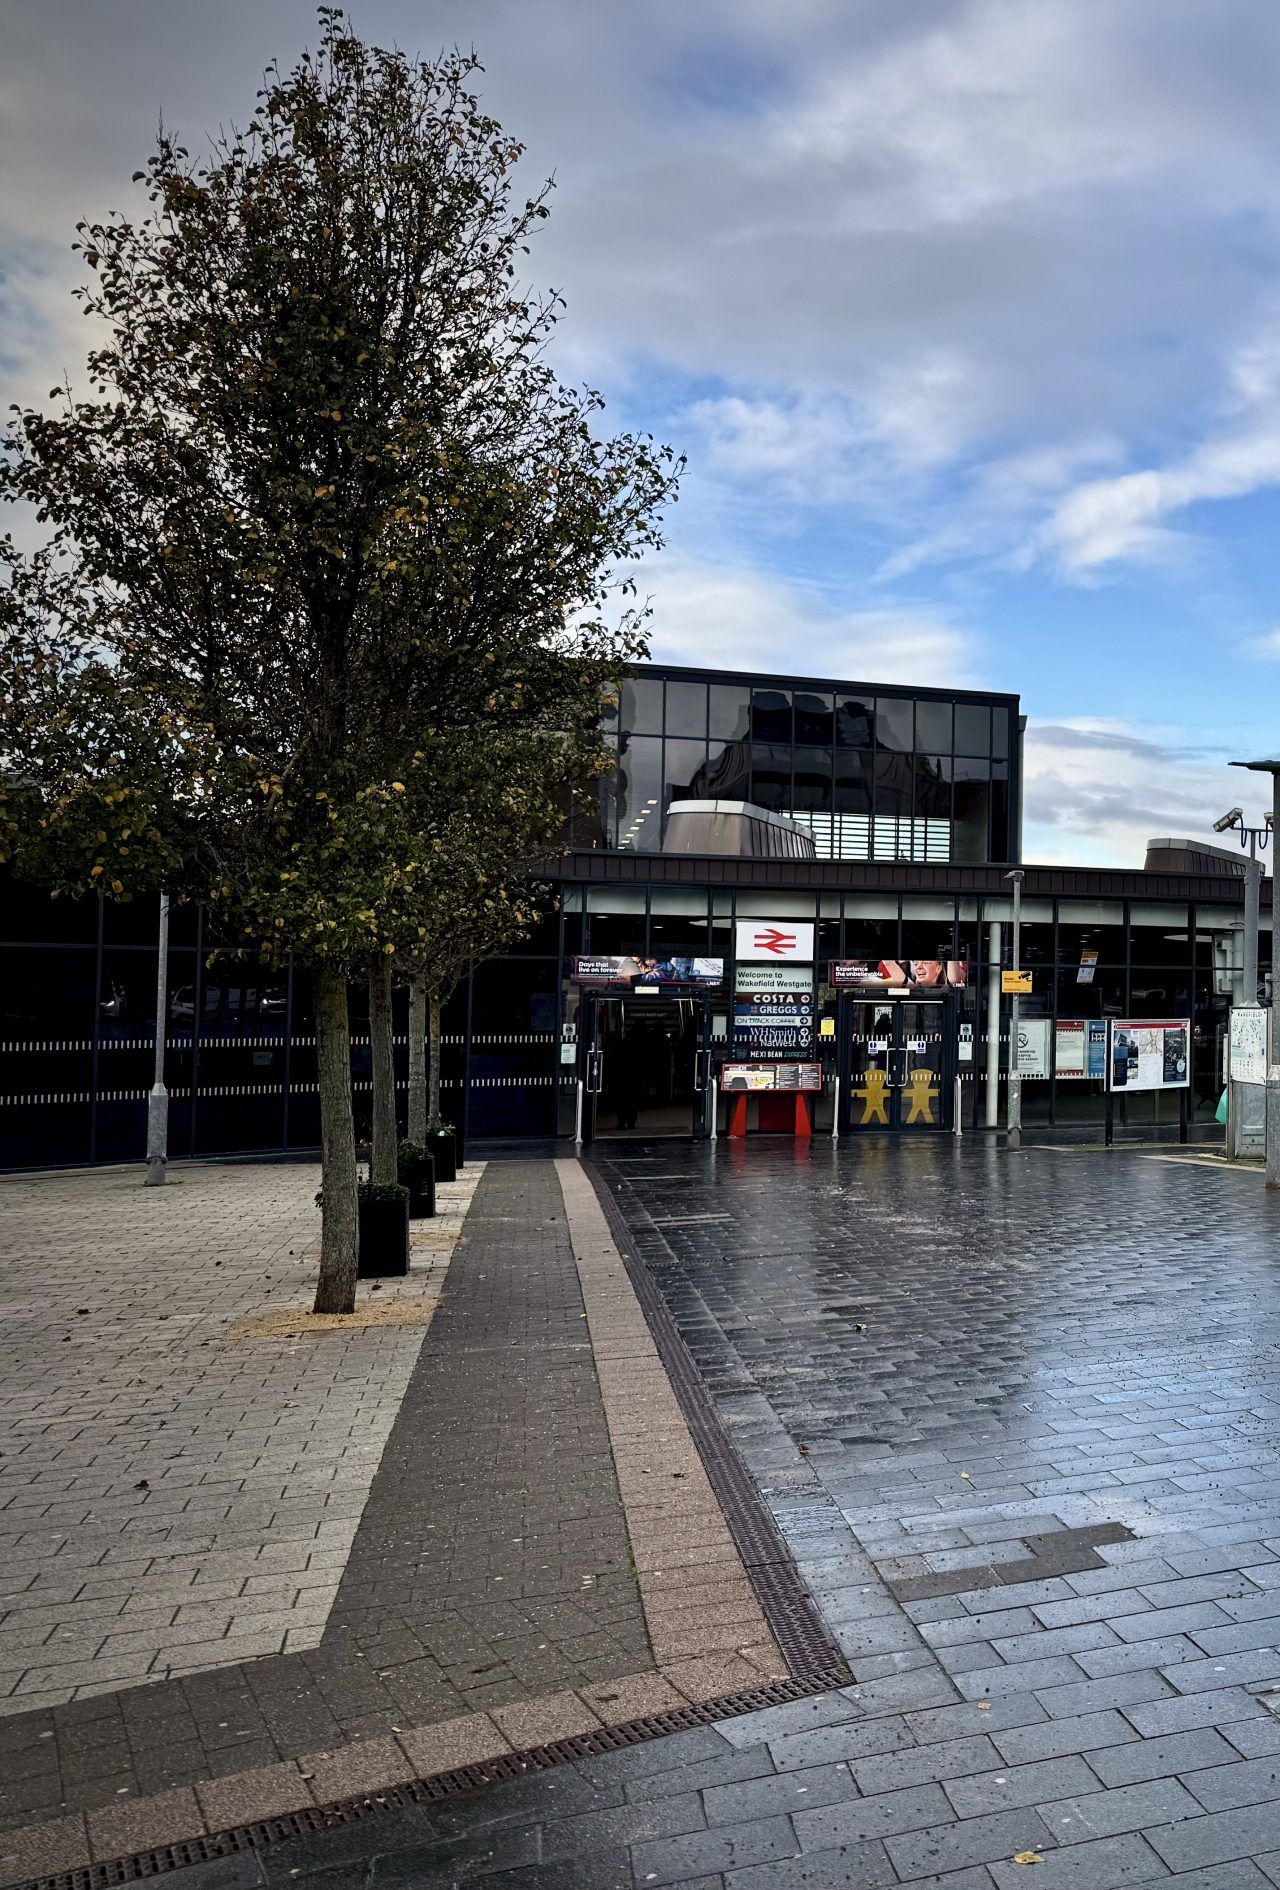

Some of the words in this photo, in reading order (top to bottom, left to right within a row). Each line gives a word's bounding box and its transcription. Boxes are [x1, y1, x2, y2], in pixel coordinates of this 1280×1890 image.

[835, 965, 868, 973] Experience
[737, 971, 773, 979] Welcome
[774, 971, 783, 979] to
[776, 980, 812, 988] Westgate
[753, 994, 795, 1004] COSTA
[759, 1005, 797, 1014] GREGGS
[750, 1027, 796, 1036] WHSmith
[760, 1039, 796, 1047] NatWest
